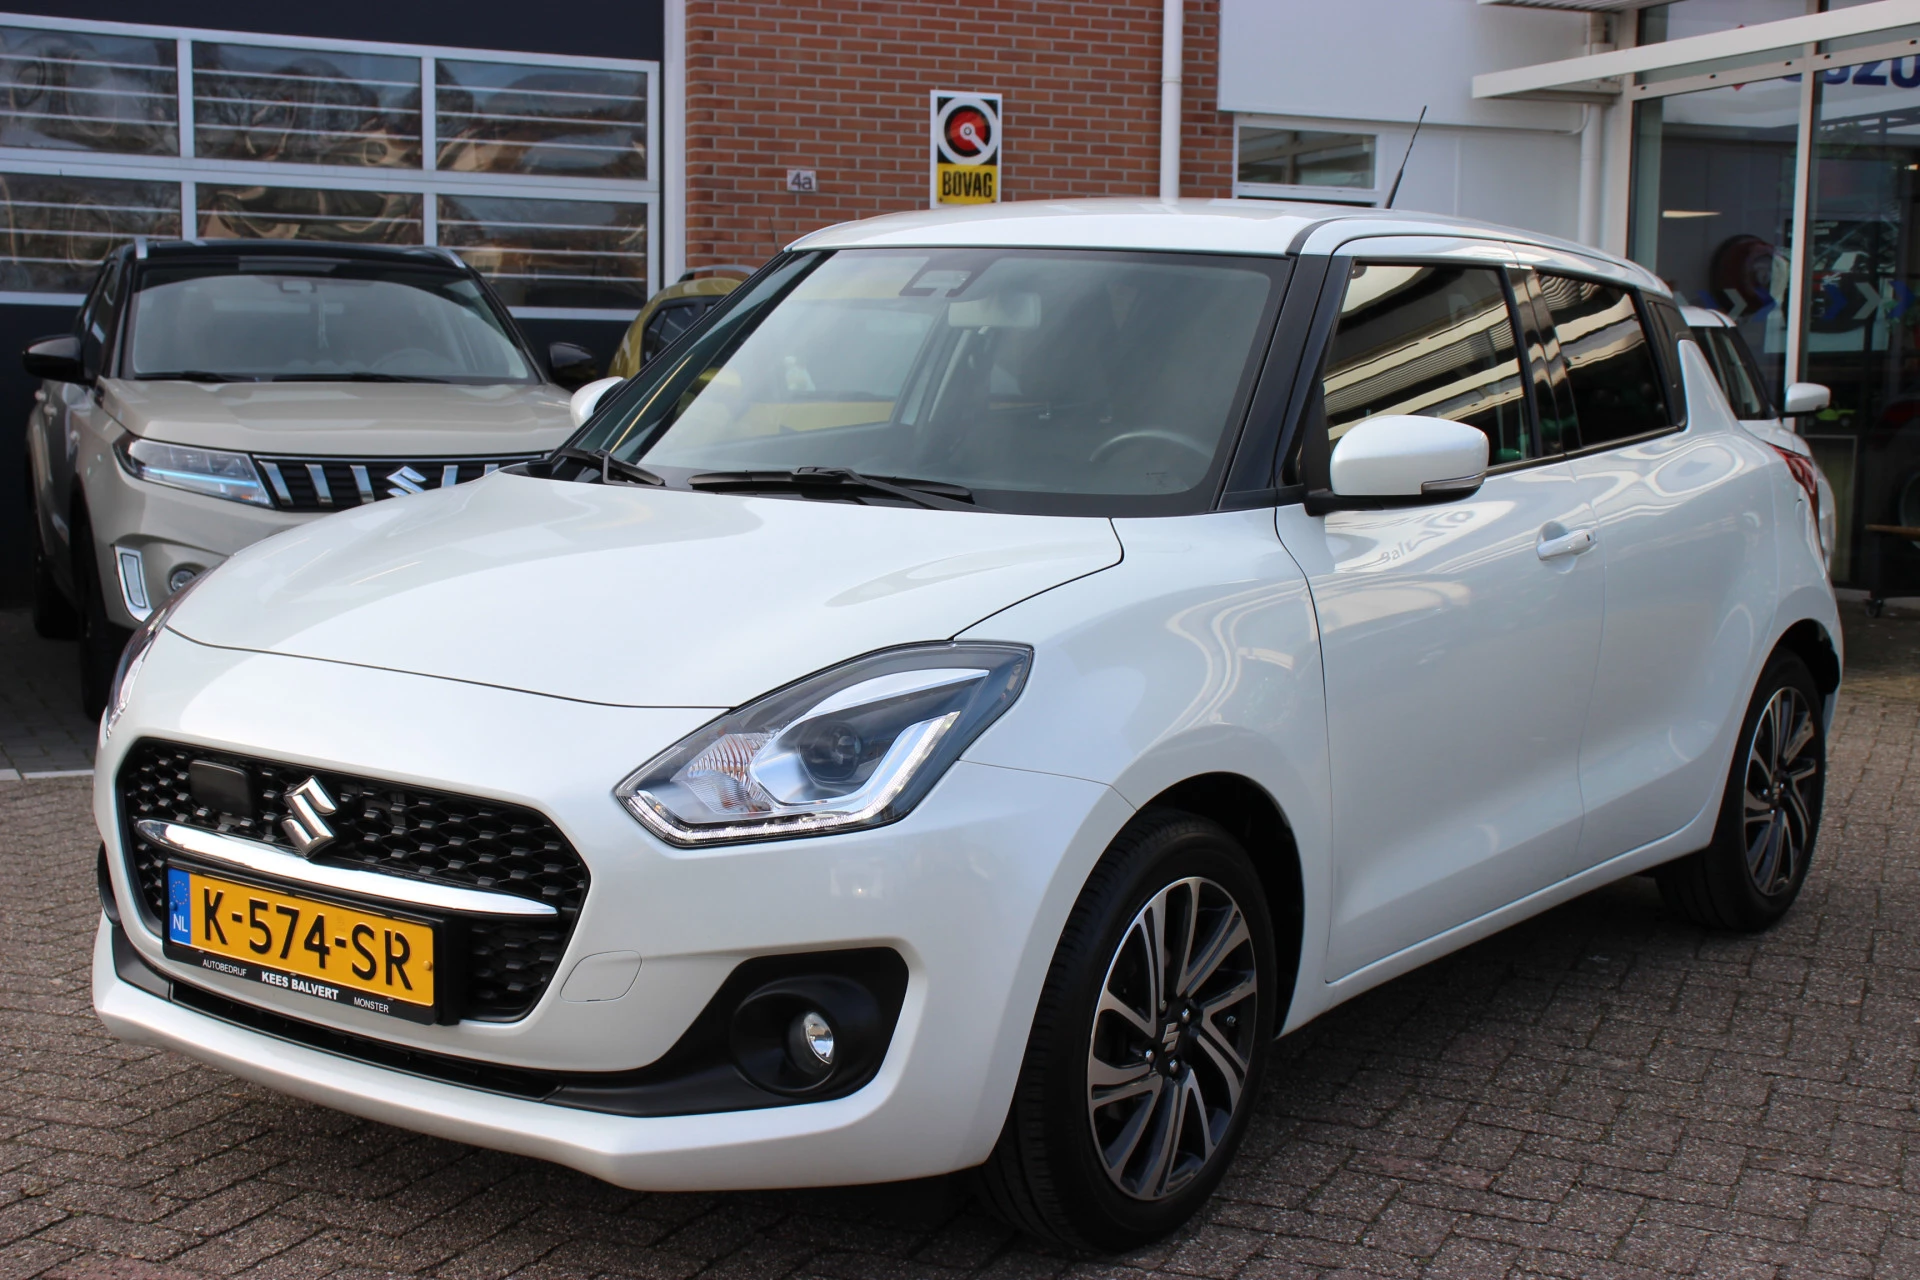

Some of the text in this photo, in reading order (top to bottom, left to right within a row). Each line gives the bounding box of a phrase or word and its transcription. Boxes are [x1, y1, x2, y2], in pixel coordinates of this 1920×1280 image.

[791, 173, 813, 190] 4a
[942, 171, 993, 198] BOVAG
[173, 914, 188, 933] NL
[203, 886, 413, 991] K-574-SR
[202, 959, 390, 1014] AUTOBEDRIJF KEES BALVERT MONSTER
